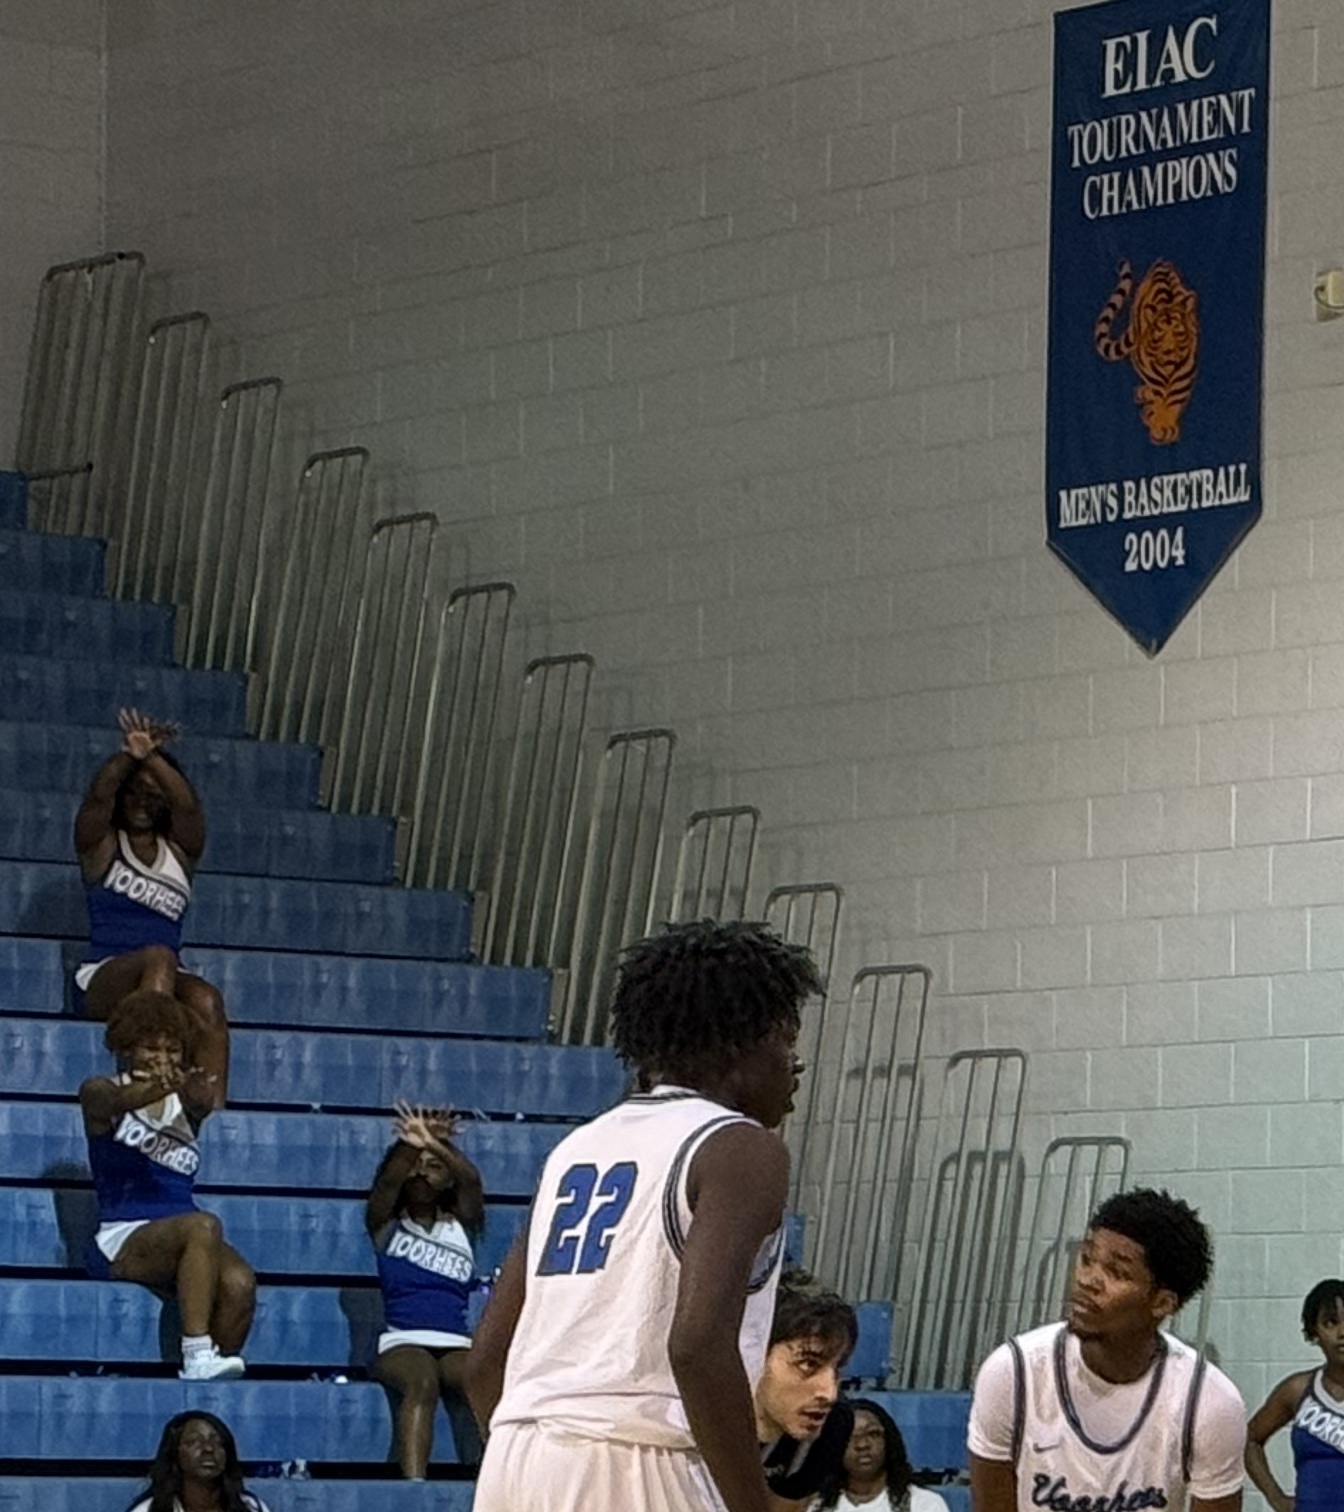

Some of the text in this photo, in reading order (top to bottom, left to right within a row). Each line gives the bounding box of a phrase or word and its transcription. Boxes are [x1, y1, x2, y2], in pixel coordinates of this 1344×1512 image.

[1102, 14, 1218, 98] EIAC
[1068, 88, 1255, 168] TOURNAMENT
[1083, 149, 1238, 219] CHAMPIONS
[1058, 463, 1251, 528] MEN'S BASKETBALL
[1124, 526, 1186, 572] 2004
[535, 1161, 638, 1277] 22
